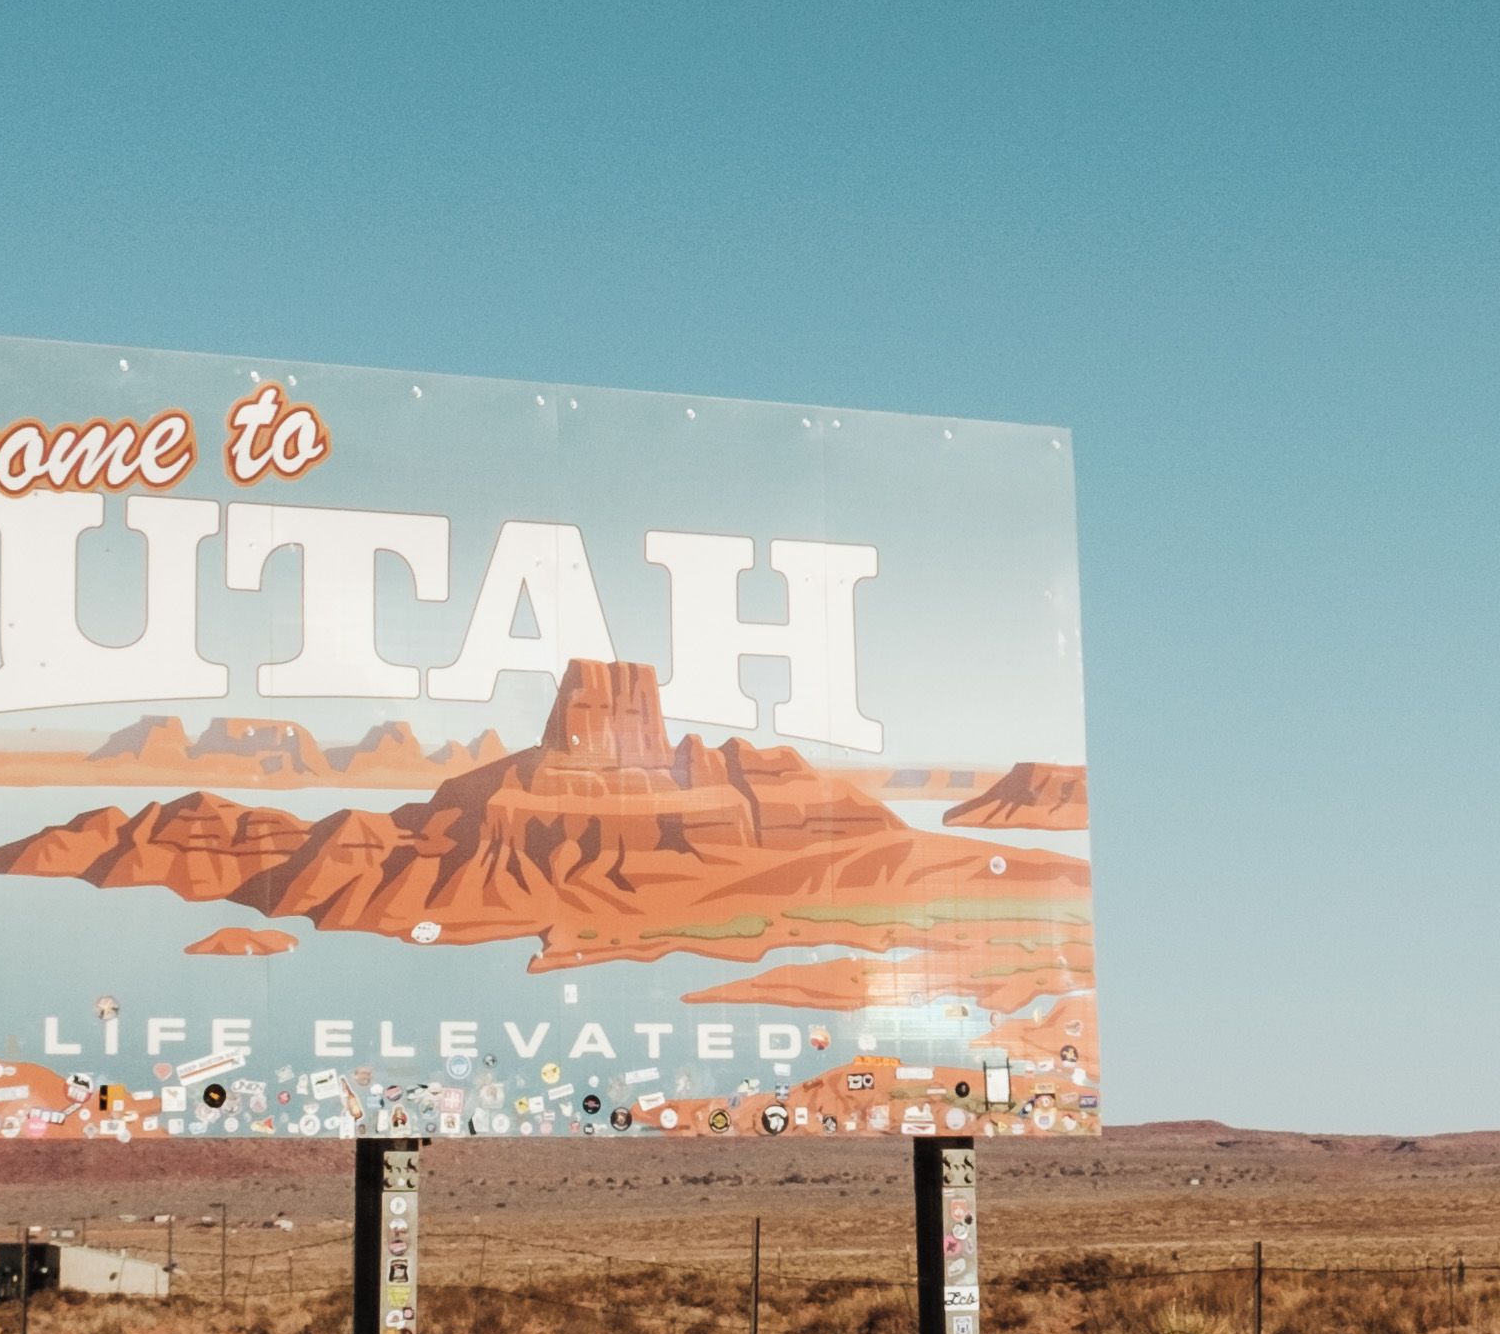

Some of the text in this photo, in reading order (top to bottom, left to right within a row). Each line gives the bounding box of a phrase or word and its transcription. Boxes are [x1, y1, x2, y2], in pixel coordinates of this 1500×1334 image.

[223, 382, 331, 485] to
[44, 1017, 802, 1060] LIFE ELEVATED
